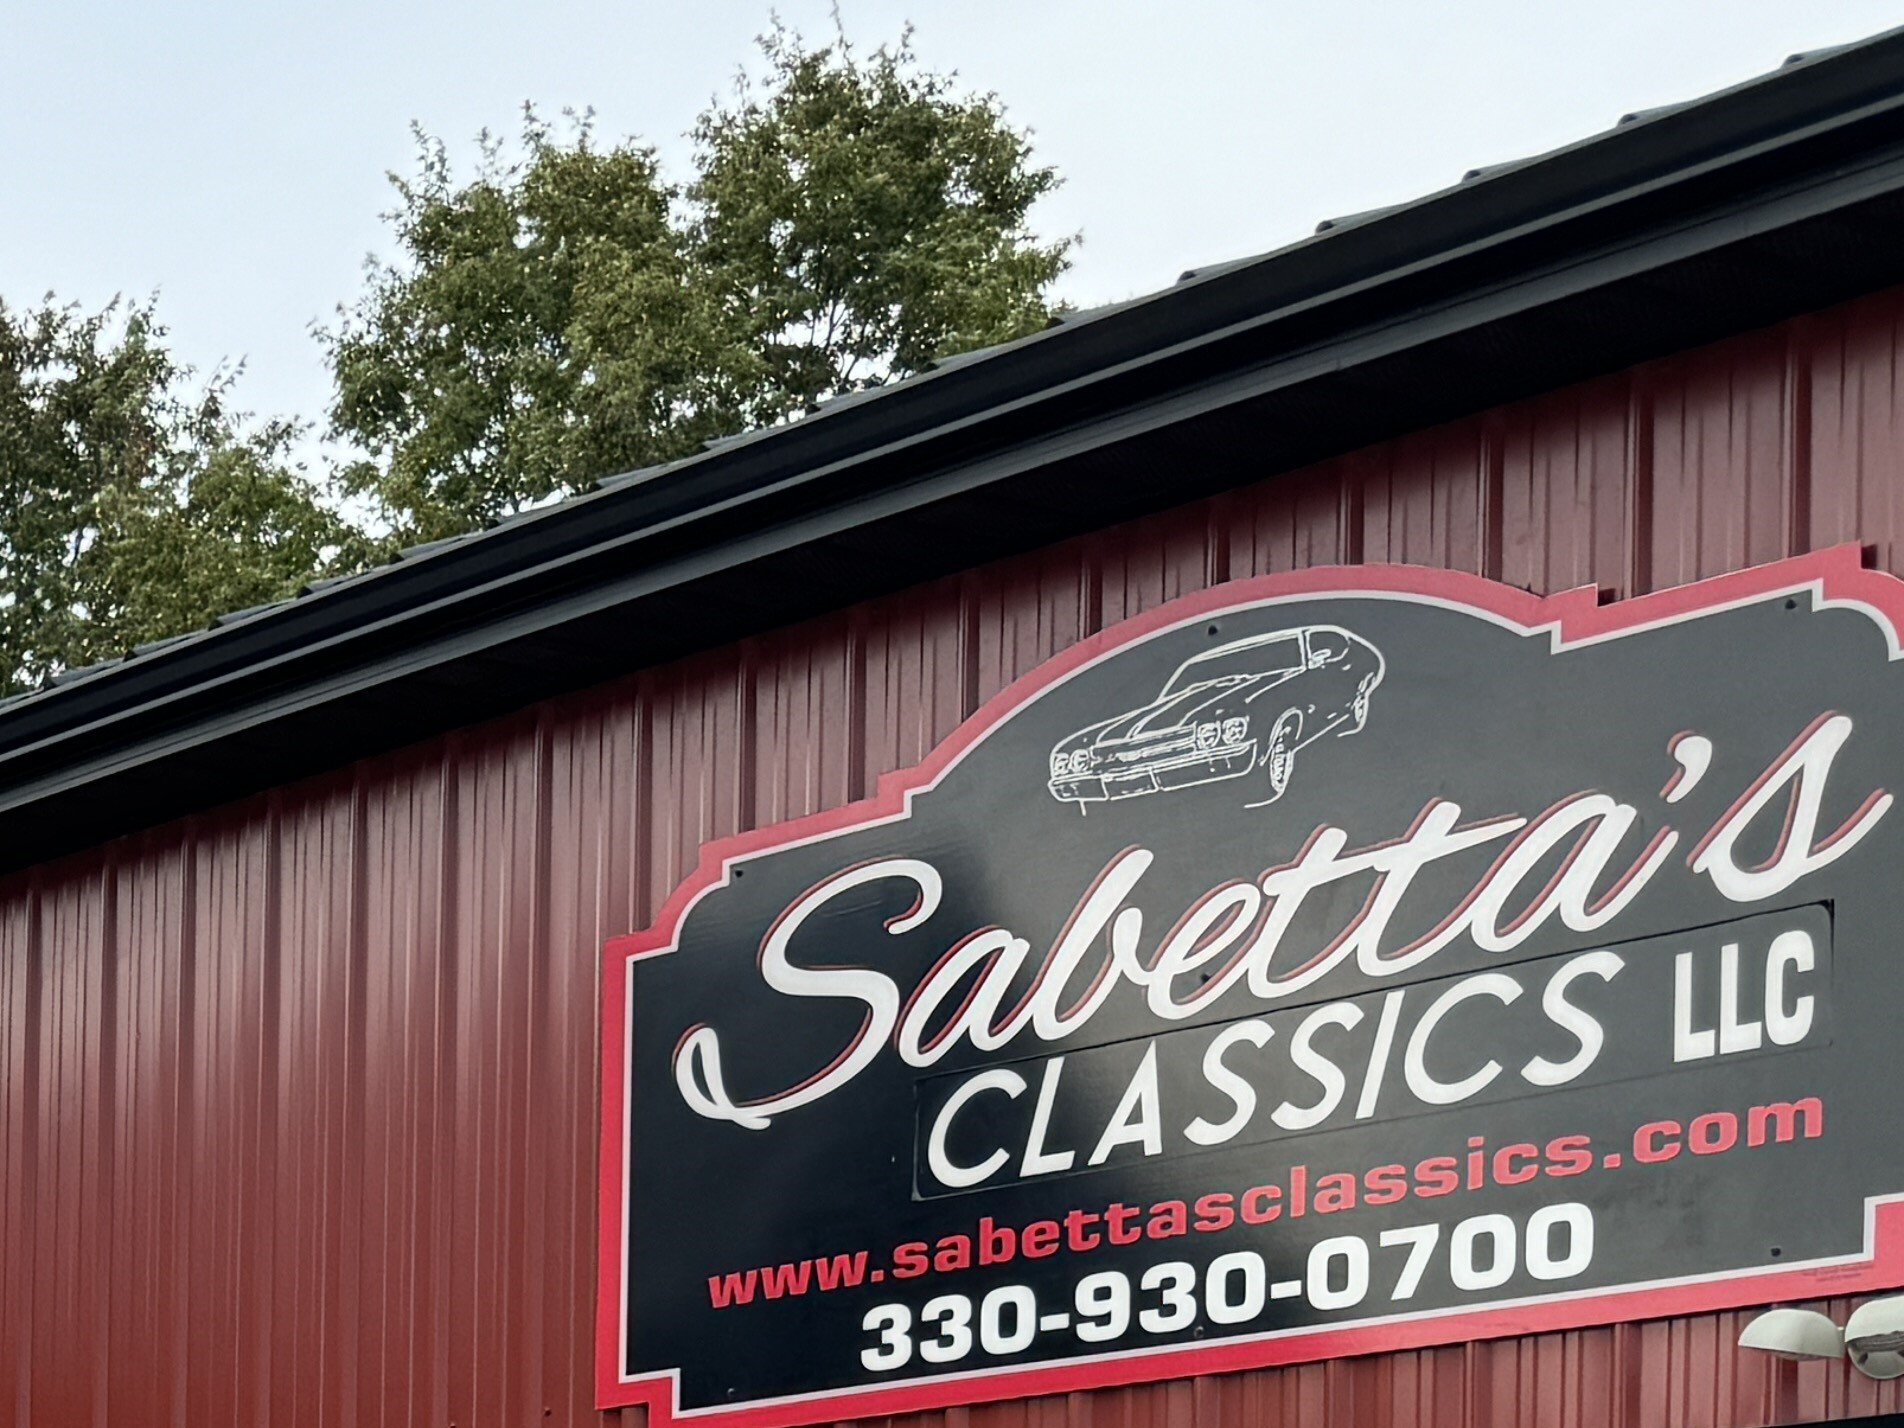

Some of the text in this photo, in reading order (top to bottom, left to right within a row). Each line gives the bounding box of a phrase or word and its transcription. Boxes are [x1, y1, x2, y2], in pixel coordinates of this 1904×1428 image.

[672, 709, 1895, 1130] Sabetta's
[927, 929, 1815, 1188] CLASSICS LLC
[707, 1096, 1824, 1309] www.sabettasclassics.com
[859, 1202, 1595, 1372] 330-930-0700
